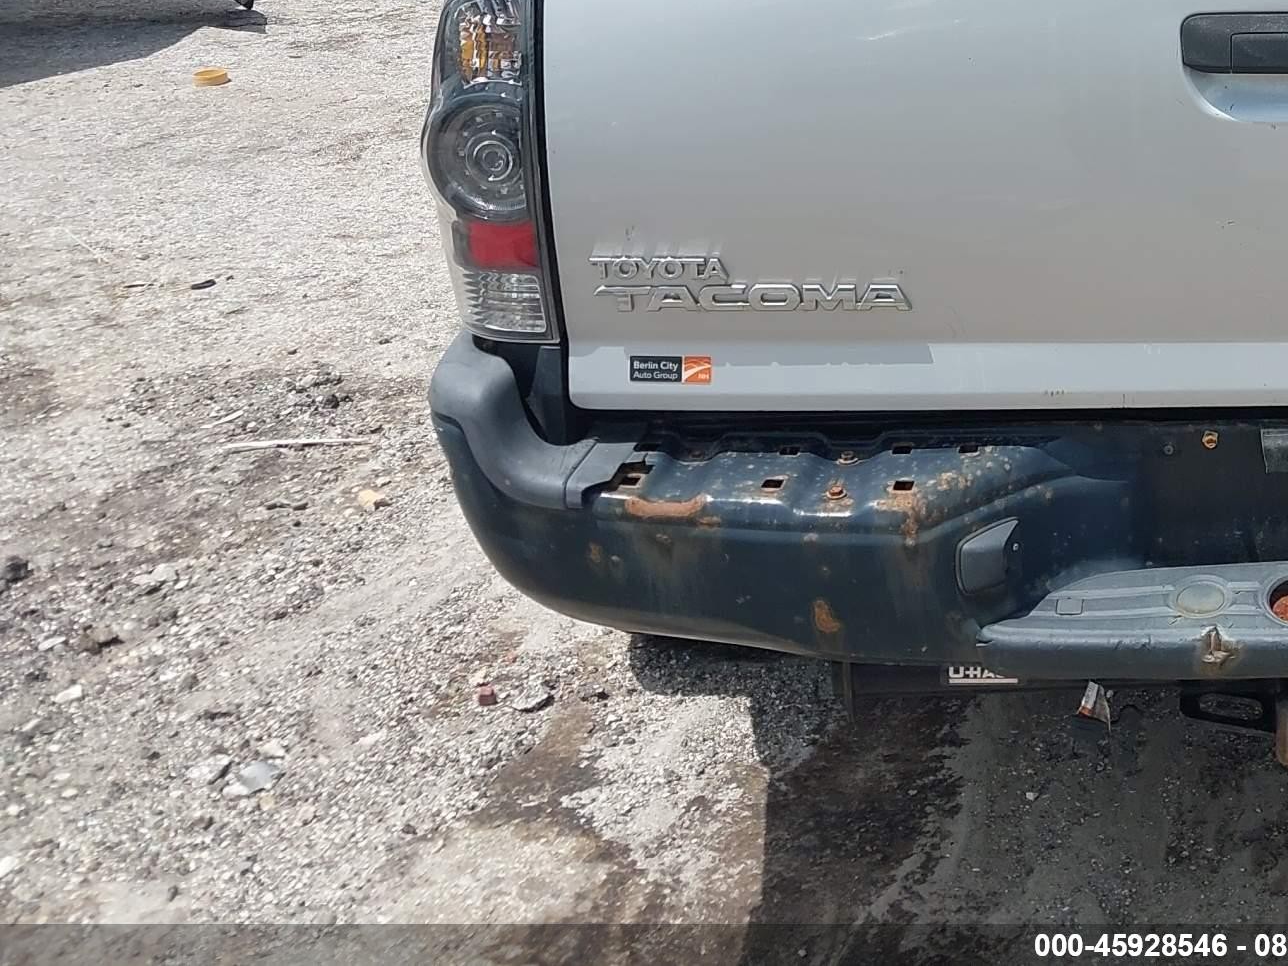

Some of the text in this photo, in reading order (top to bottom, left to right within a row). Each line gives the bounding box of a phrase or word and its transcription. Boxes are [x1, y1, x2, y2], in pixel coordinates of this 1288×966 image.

[588, 255, 730, 281] TOYOTA
[593, 283, 912, 312] TACOMA
[633, 360, 679, 372] Berlin City
[633, 371, 679, 382] Auto Group
[948, 666, 1006, 679] U-HA
